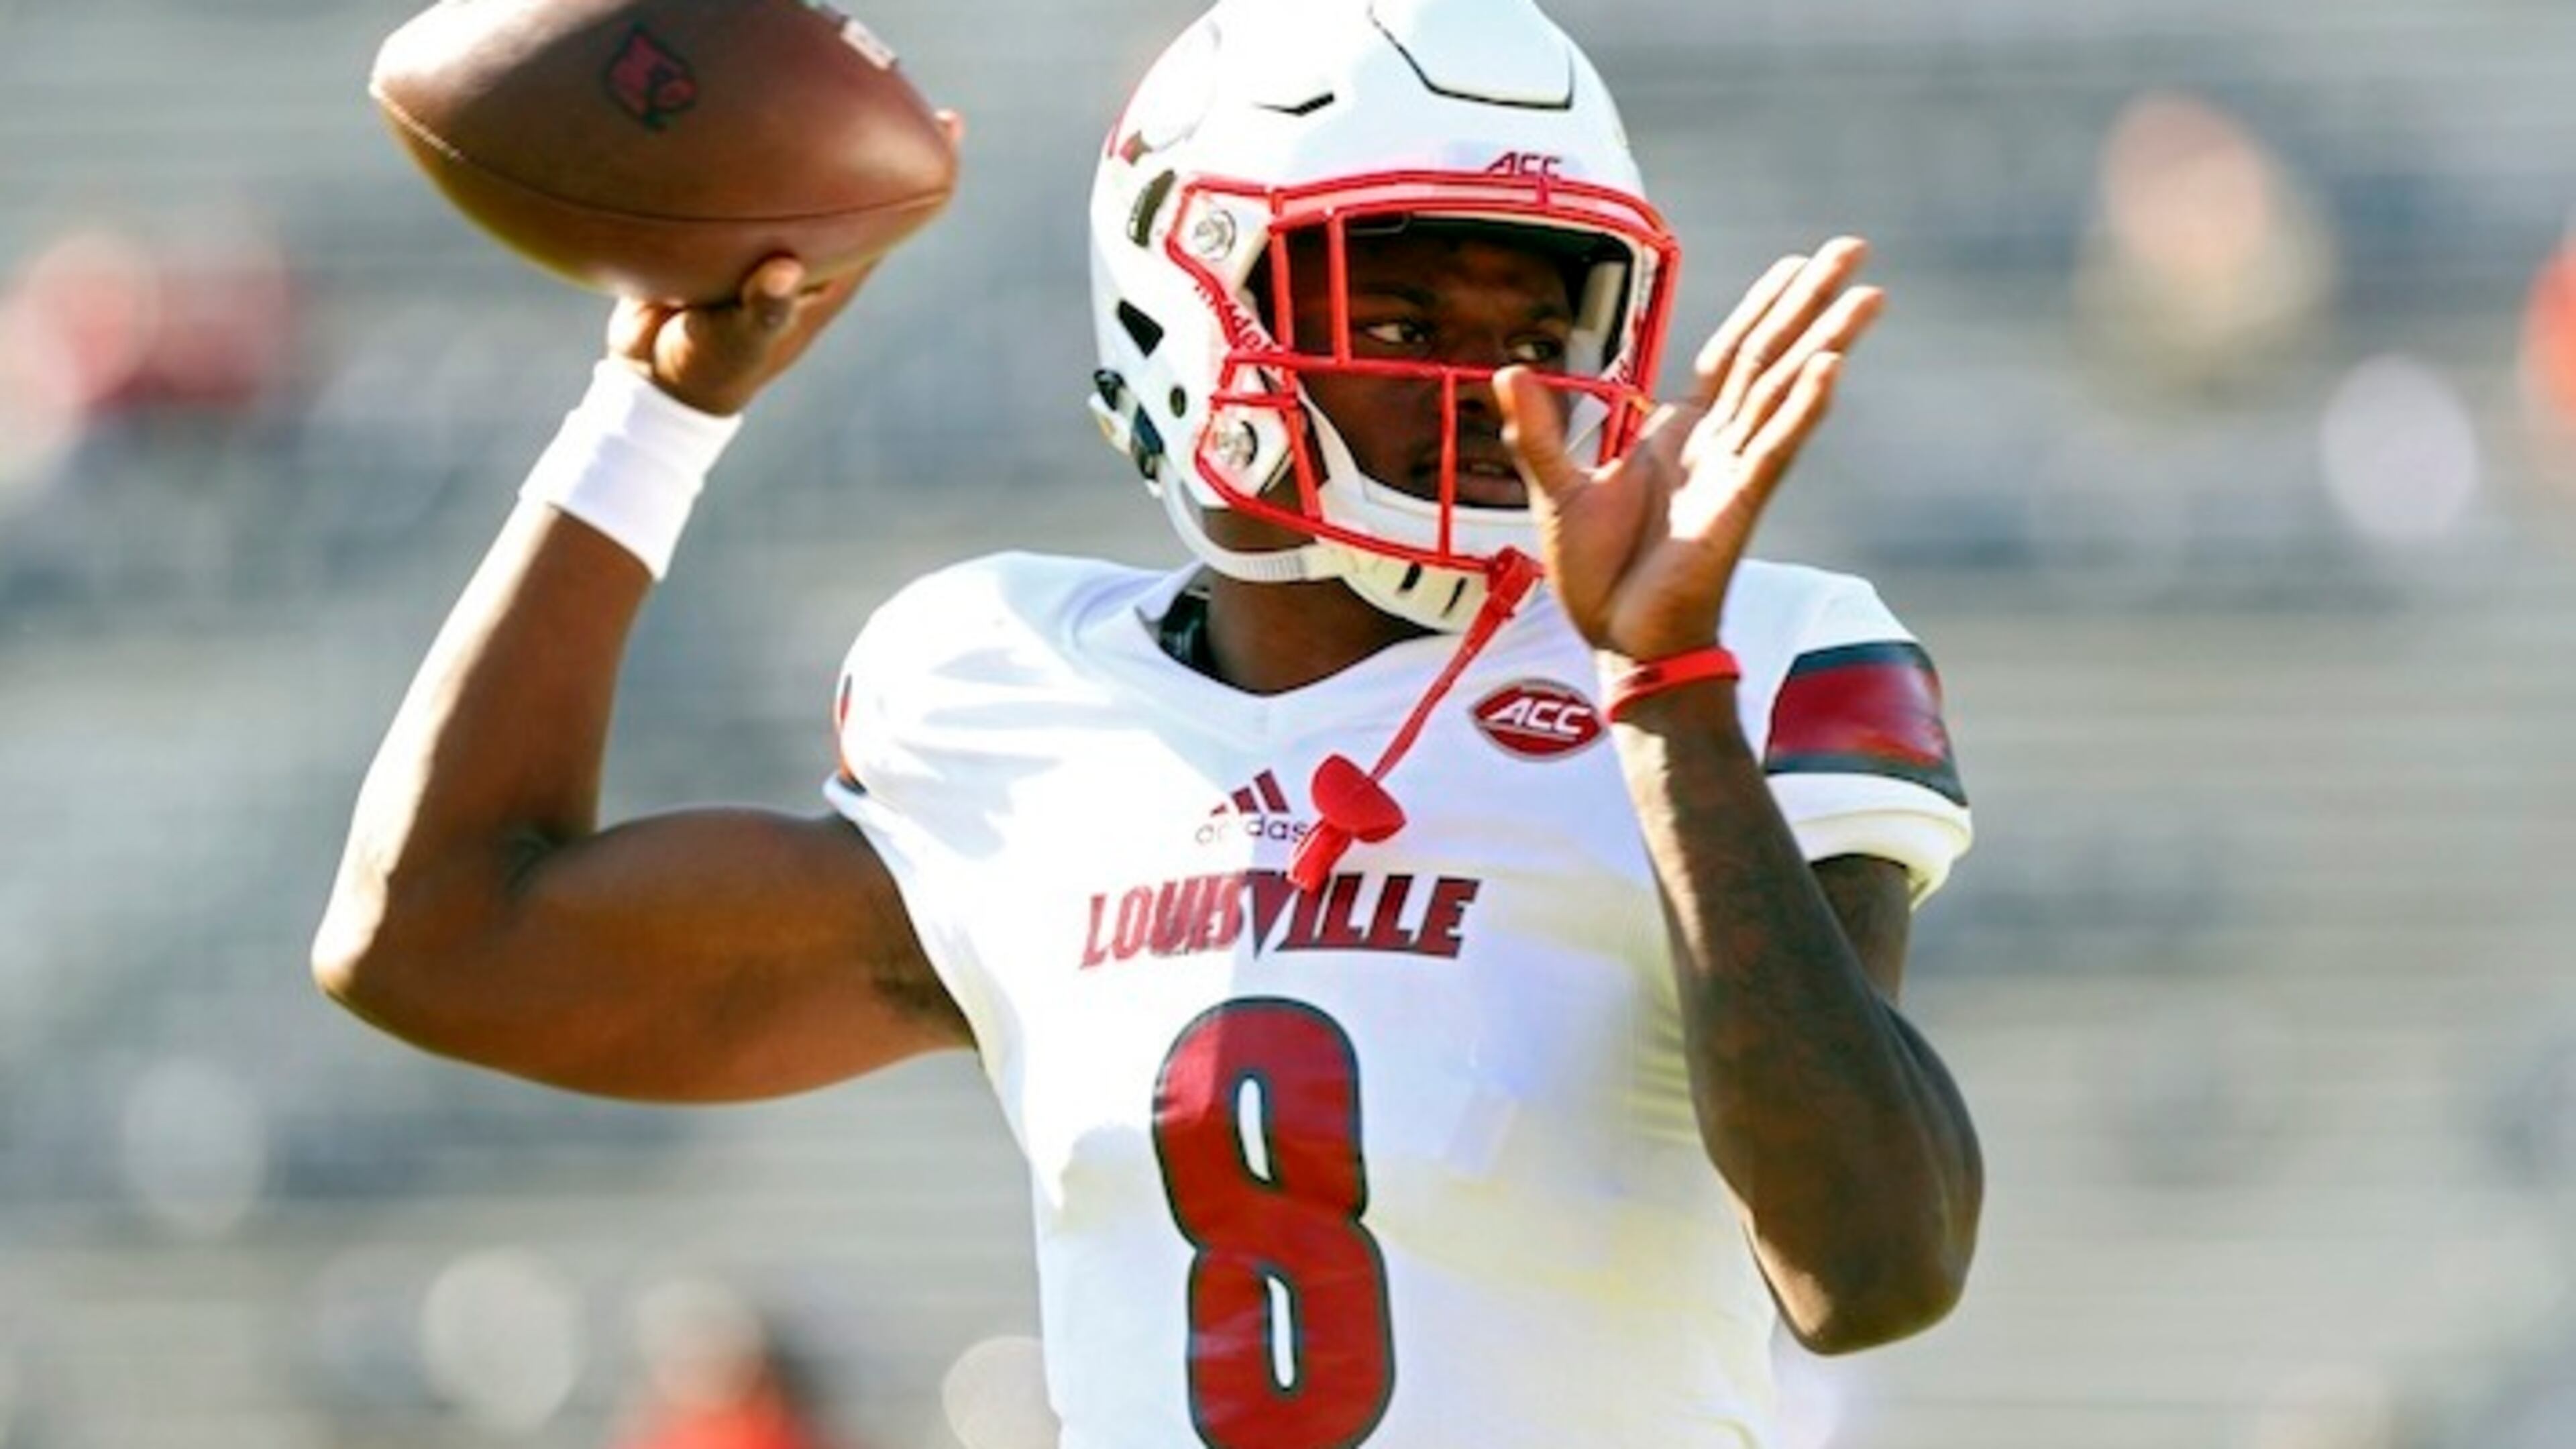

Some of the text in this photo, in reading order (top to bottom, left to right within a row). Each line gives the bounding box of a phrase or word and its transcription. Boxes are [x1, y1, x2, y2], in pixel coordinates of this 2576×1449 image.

[1485, 152, 1562, 178] ACC
[1487, 696, 1591, 735] ACC
[1079, 869, 1480, 968] LOUISVILLE
[1152, 996, 1395, 1449] 8
